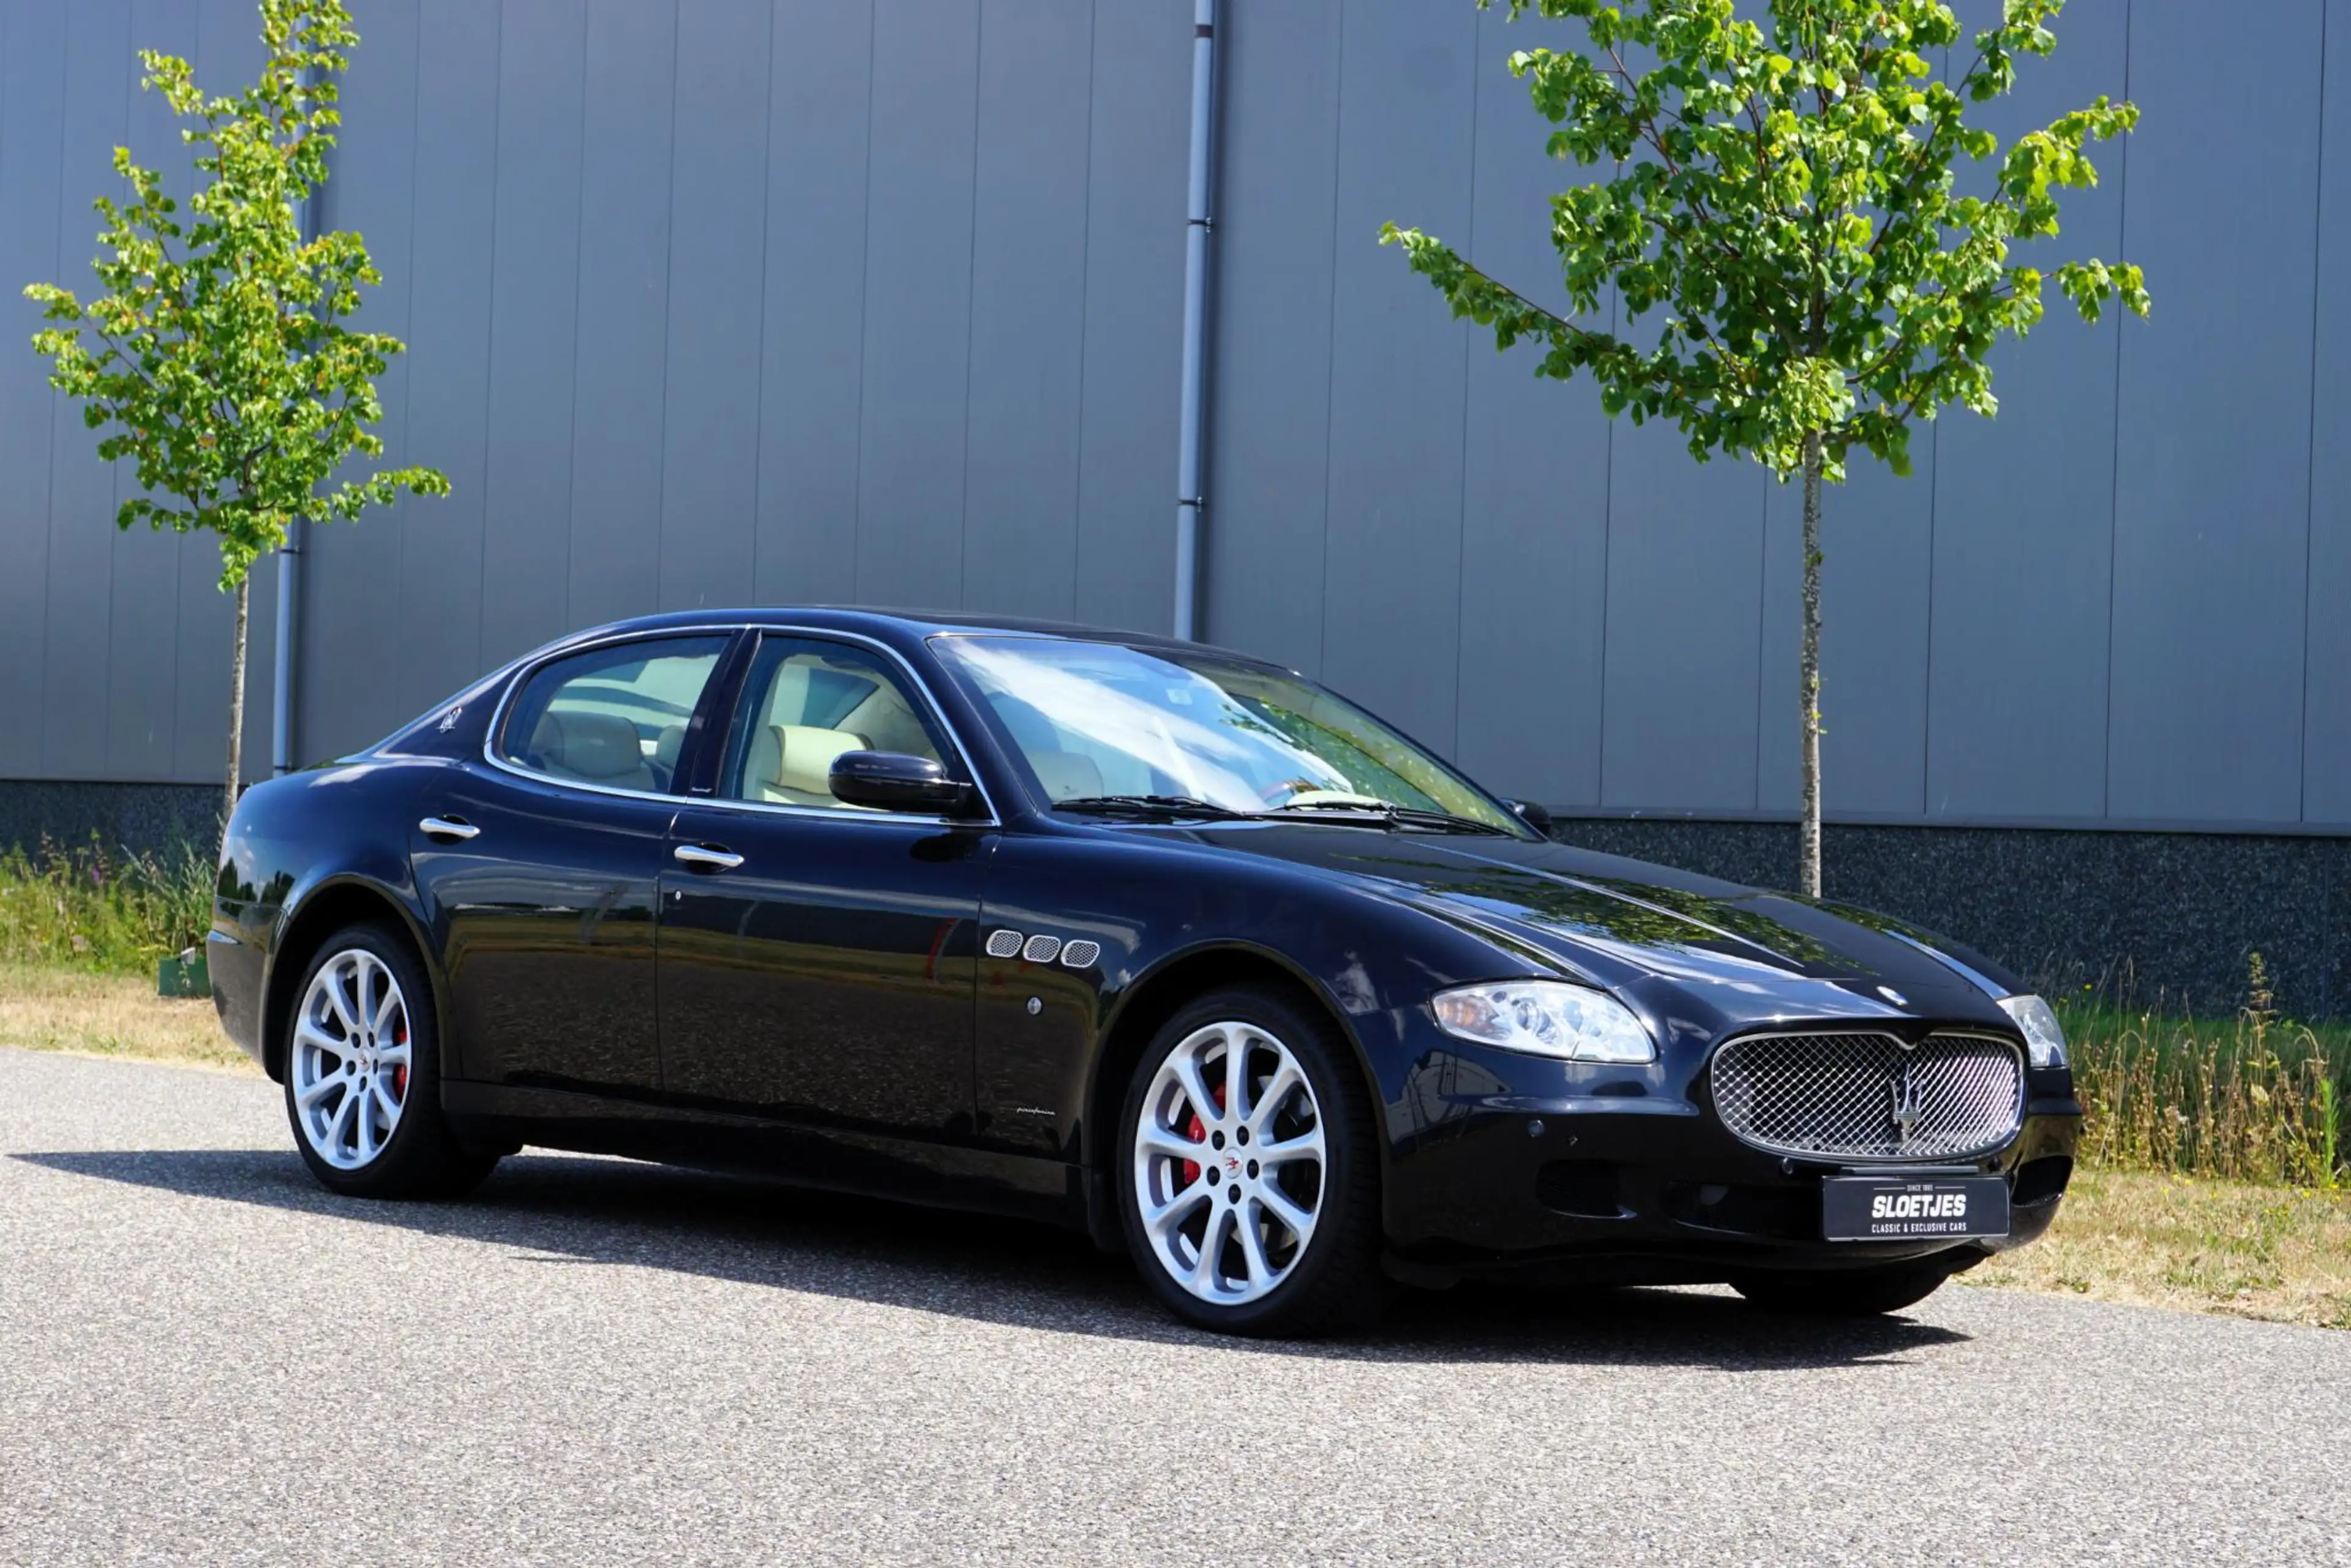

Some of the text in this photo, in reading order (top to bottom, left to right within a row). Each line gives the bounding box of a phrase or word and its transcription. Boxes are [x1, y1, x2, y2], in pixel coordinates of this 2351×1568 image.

[1872, 1194, 1967, 1218] SLOETJES
[1872, 1222, 1967, 1233] CLASSIC & EXCLUSIVE CARS
